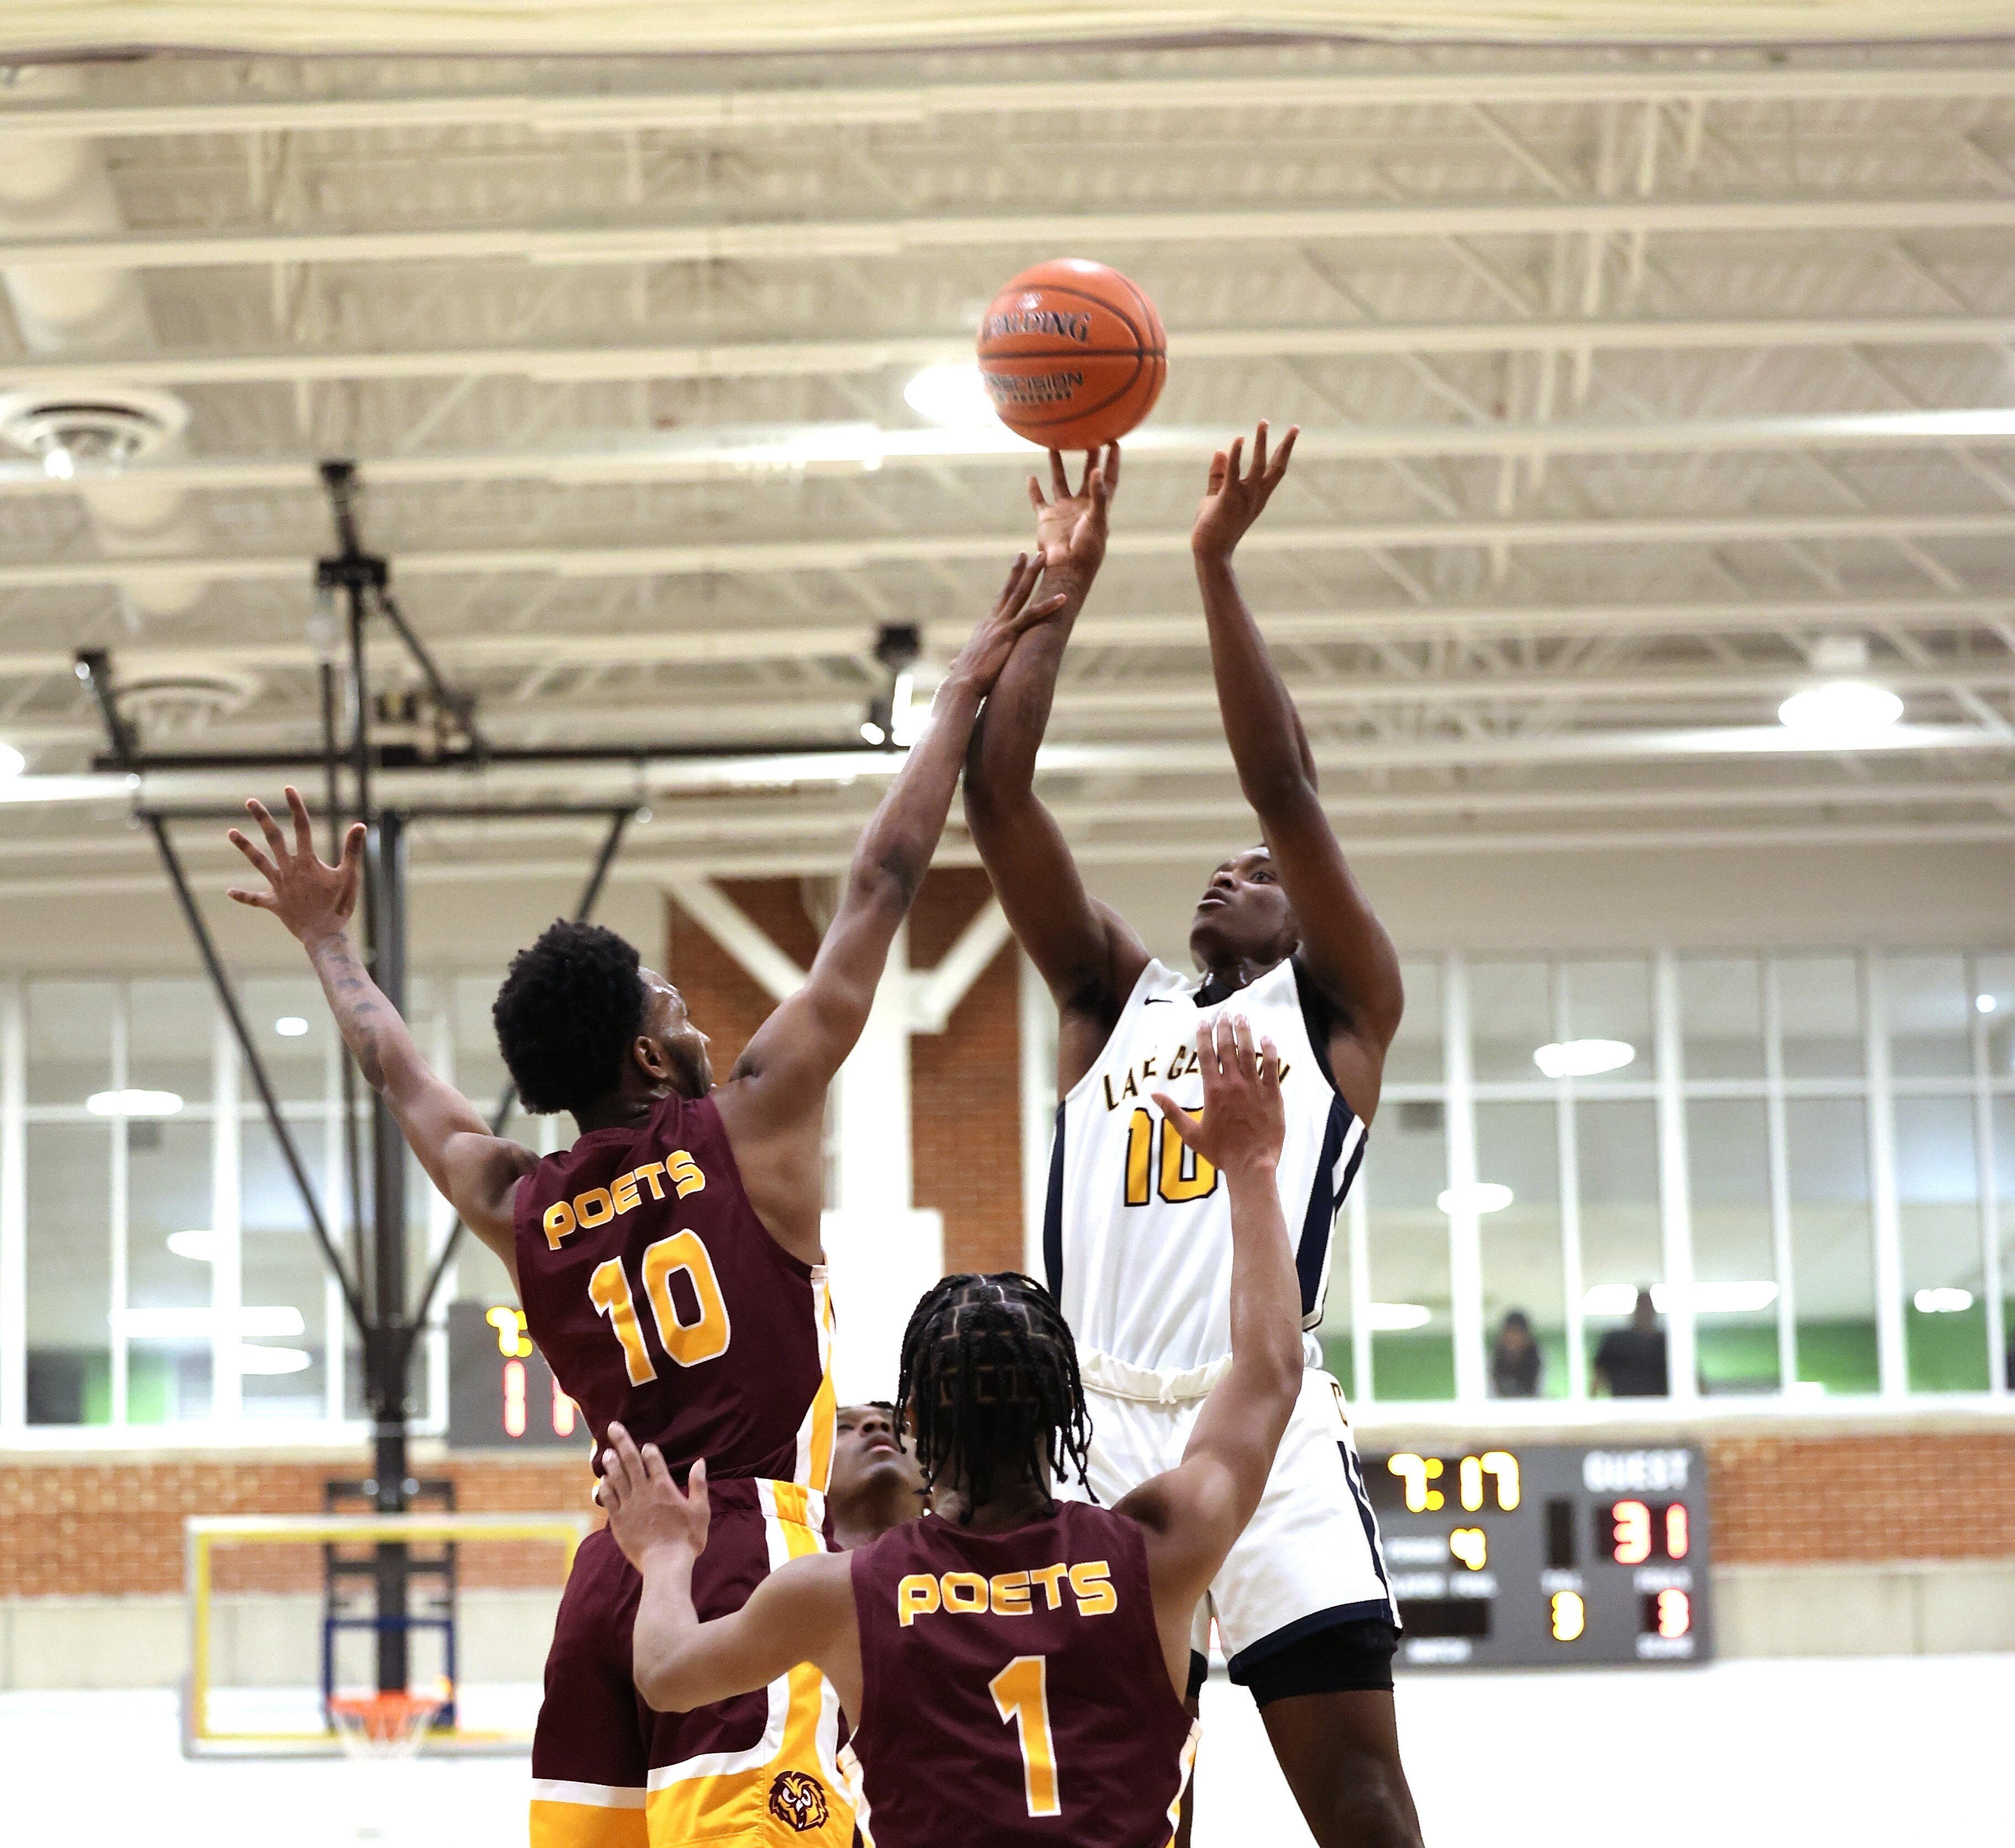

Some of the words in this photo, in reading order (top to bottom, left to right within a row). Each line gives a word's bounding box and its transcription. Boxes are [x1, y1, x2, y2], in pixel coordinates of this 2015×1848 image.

[543, 1150, 706, 1251] POETS
[1124, 1107, 1218, 1207] 10
[588, 1228, 731, 1387] 10
[1388, 1451, 1520, 1513] 7:17
[1612, 1499, 1689, 1565] 31
[898, 1560, 1117, 1627] POETS
[988, 1655, 1062, 1818] 1
